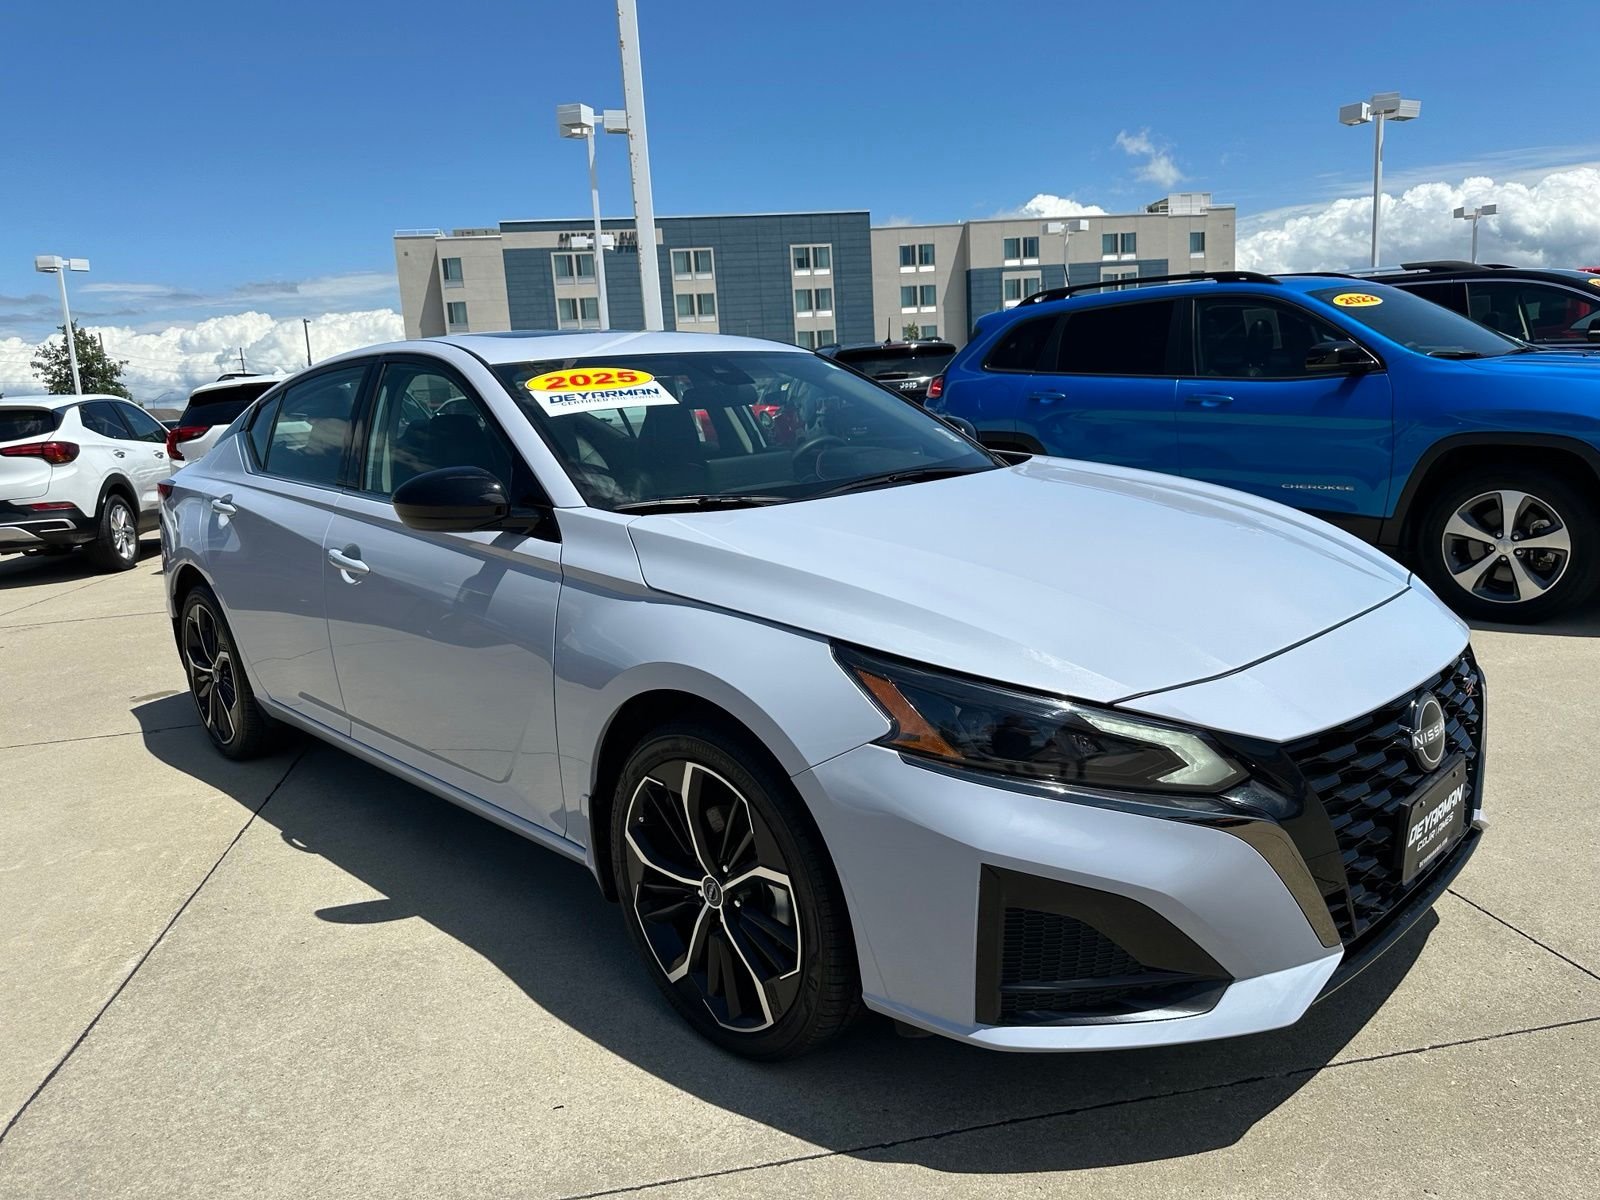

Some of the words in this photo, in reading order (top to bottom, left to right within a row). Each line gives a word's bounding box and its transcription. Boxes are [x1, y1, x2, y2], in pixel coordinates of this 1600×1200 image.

[1339, 294, 1378, 305] 2022
[545, 372, 638, 390] 2025
[899, 382, 918, 390] Jeep
[549, 388, 660, 404] DEYARMAN
[561, 397, 609, 406] CERTIFIED
[1281, 483, 1355, 491] CHEROKEE
[1408, 784, 1464, 848] DEYARMAN
